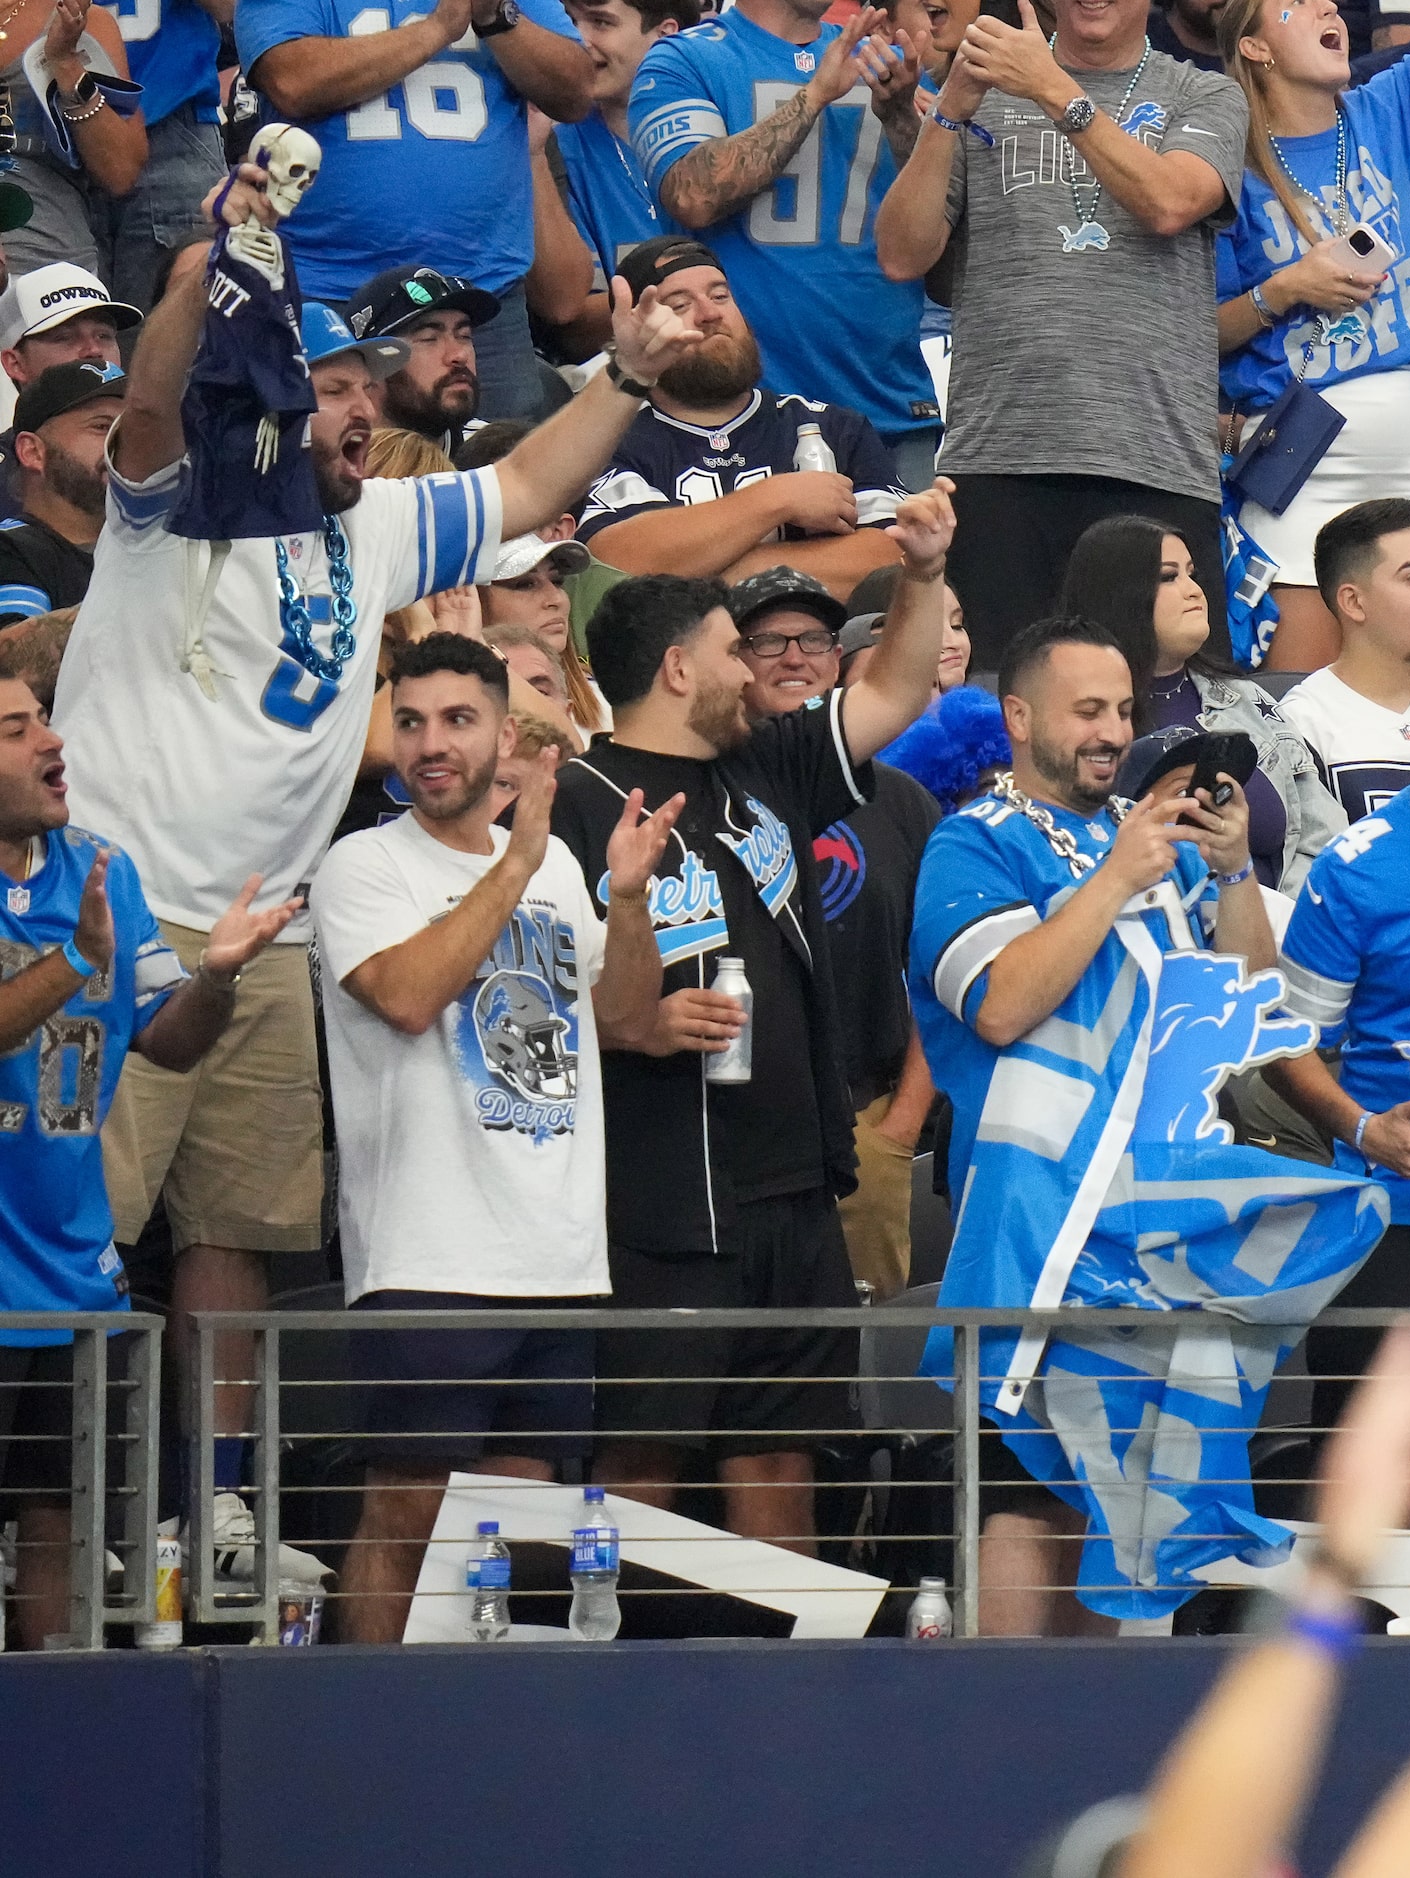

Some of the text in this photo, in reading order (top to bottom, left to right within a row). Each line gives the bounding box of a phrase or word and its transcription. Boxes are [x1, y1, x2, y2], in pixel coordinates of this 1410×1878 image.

[345, 5, 490, 142] 16
[40, 286, 110, 308] COWBOY
[475, 1087, 576, 1134] Detroi
[575, 1547, 596, 1562] BLUE
